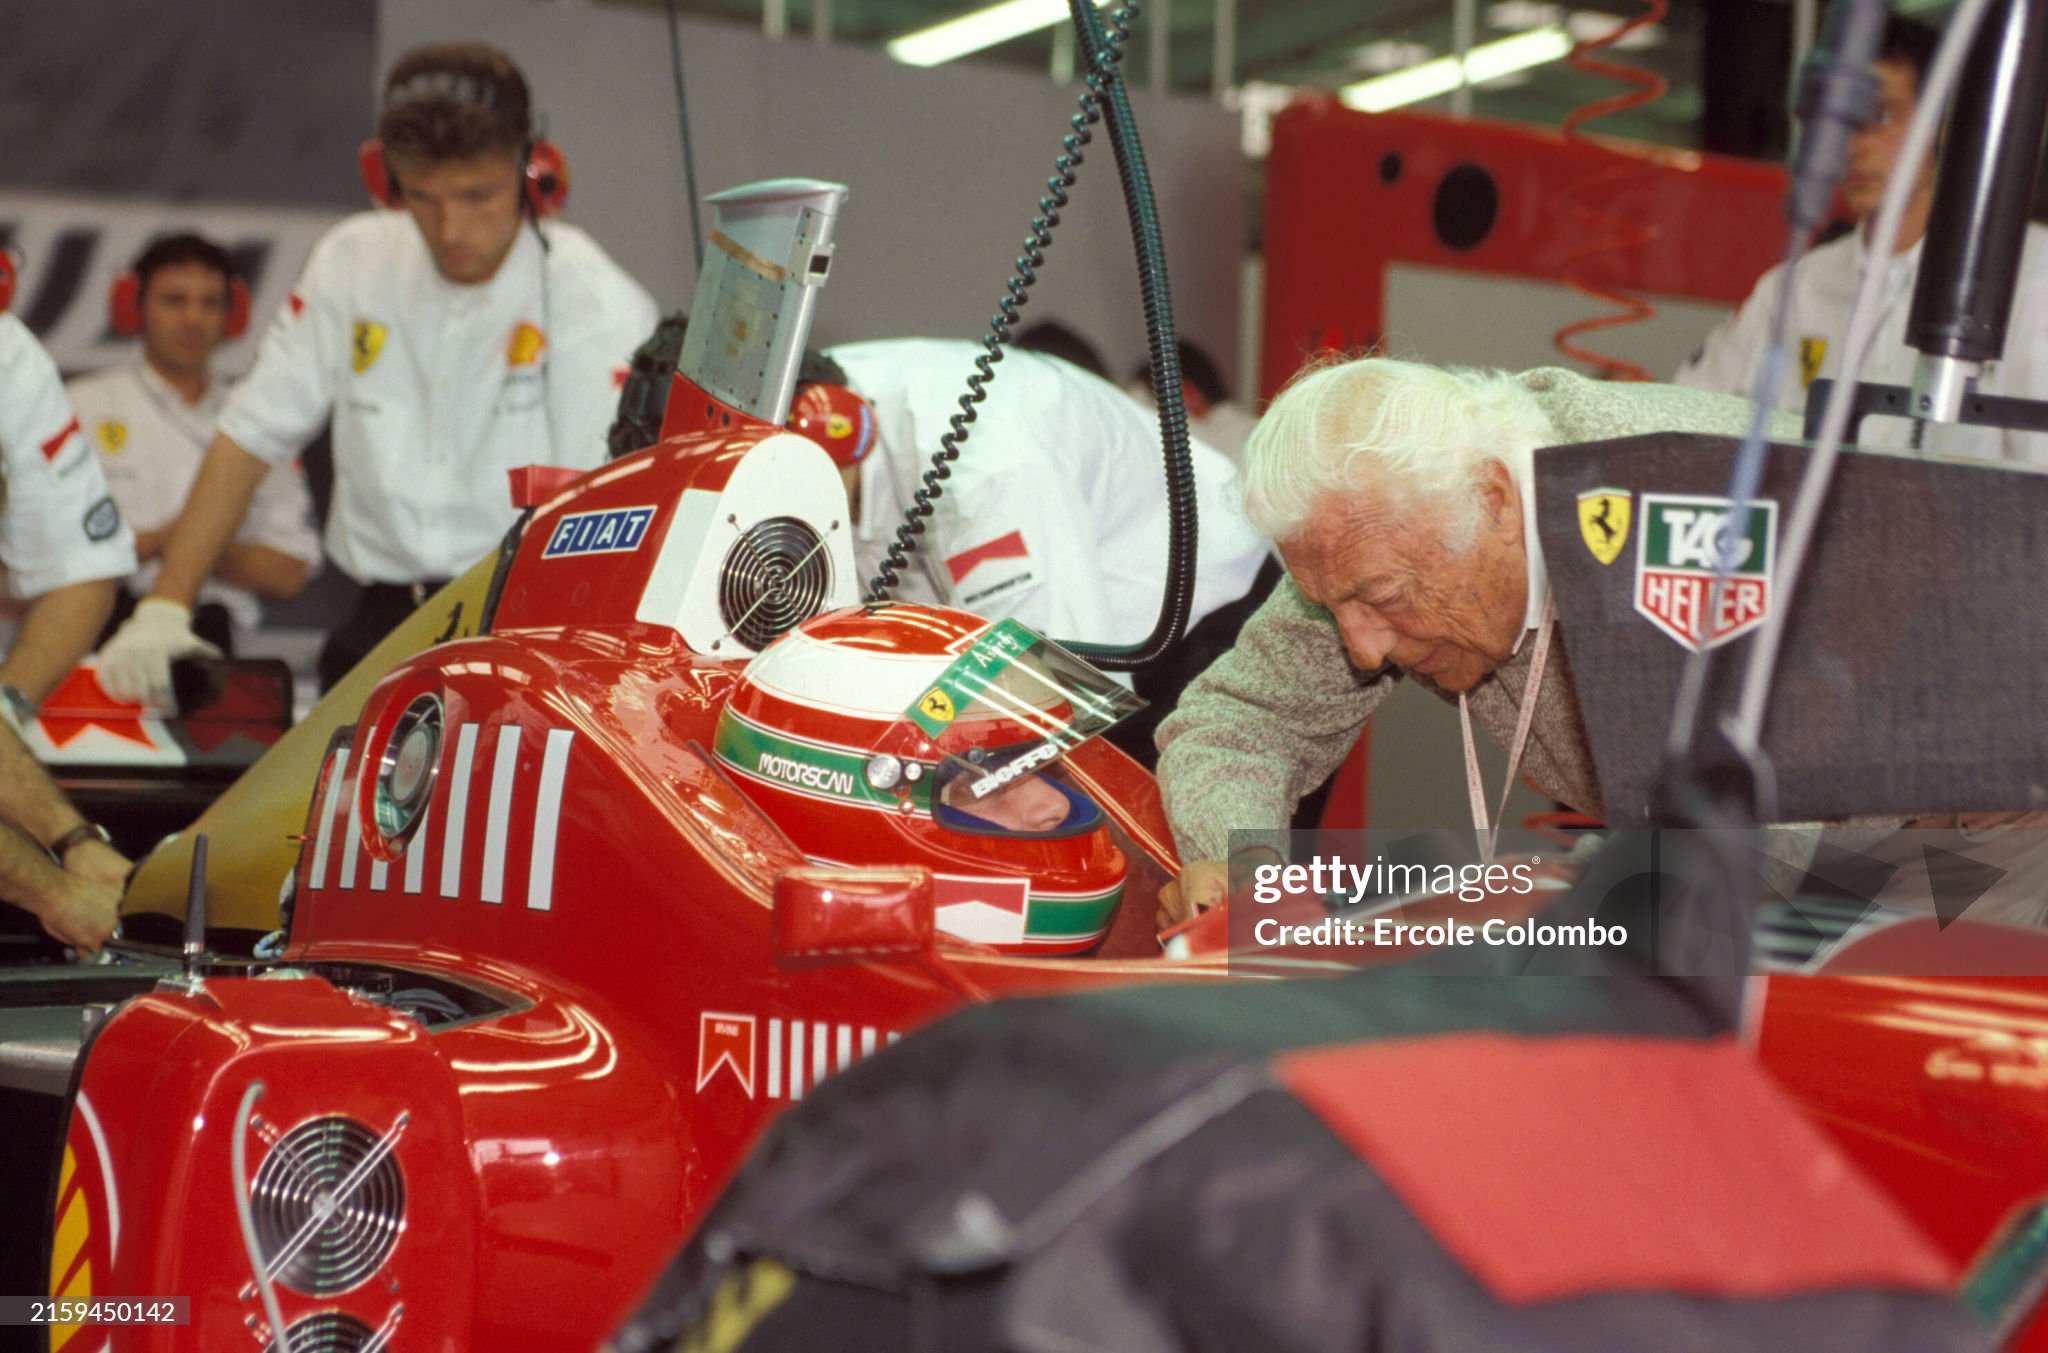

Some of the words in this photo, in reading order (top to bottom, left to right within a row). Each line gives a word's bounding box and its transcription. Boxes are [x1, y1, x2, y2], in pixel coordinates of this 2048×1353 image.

[552, 514, 647, 550] FIAT
[1661, 508, 1754, 569] TAG
[758, 753, 853, 794] MOTORSCAN
